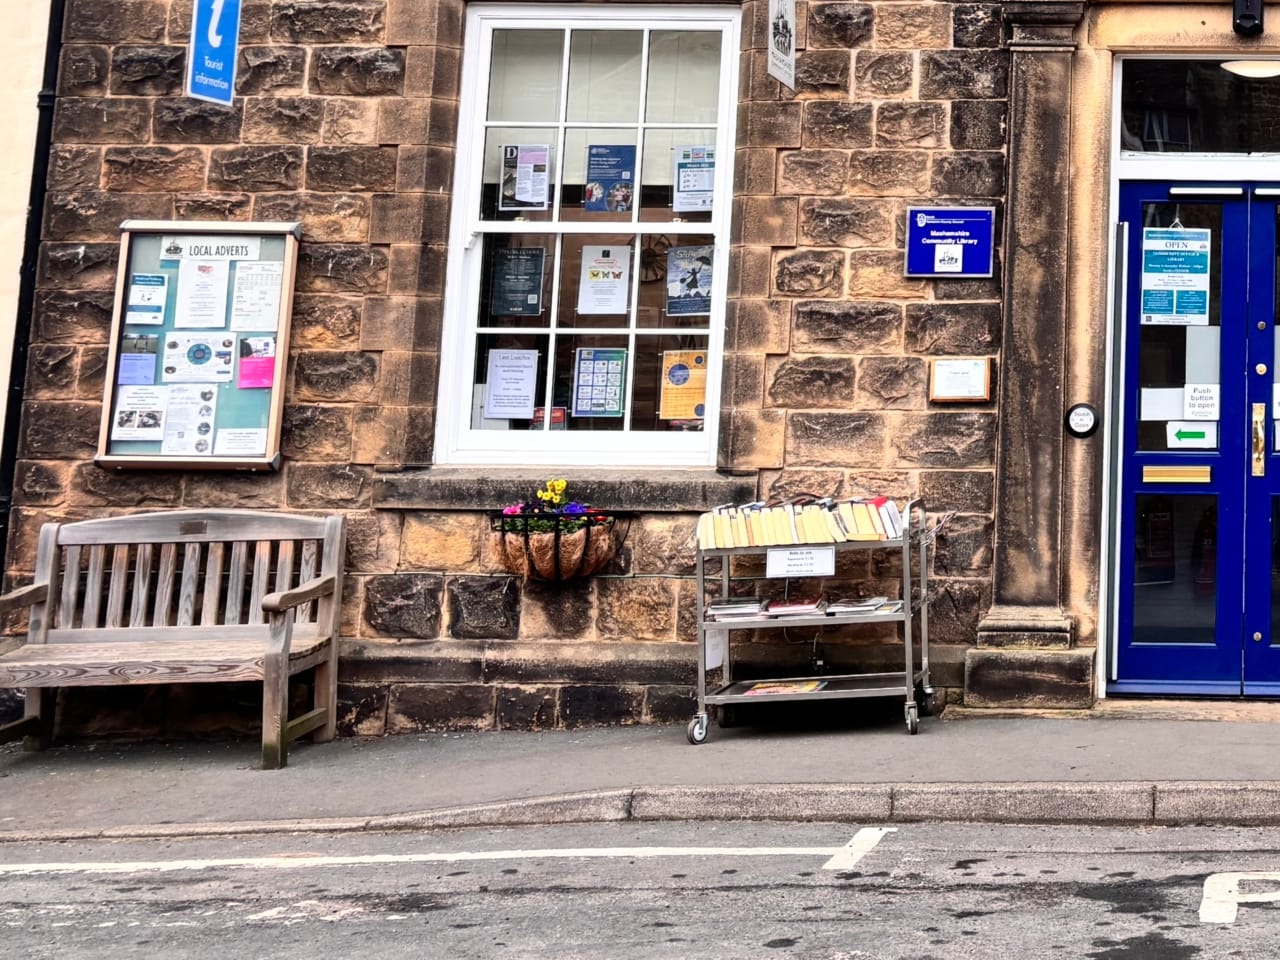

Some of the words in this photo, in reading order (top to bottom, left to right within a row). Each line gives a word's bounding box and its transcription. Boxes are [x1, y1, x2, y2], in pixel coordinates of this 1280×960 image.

[204, 54, 225, 72] Tourist
[189, 245, 213, 257] LOCAL
[215, 245, 249, 257] ADVERTS
[1165, 241, 1188, 249] OPEN
